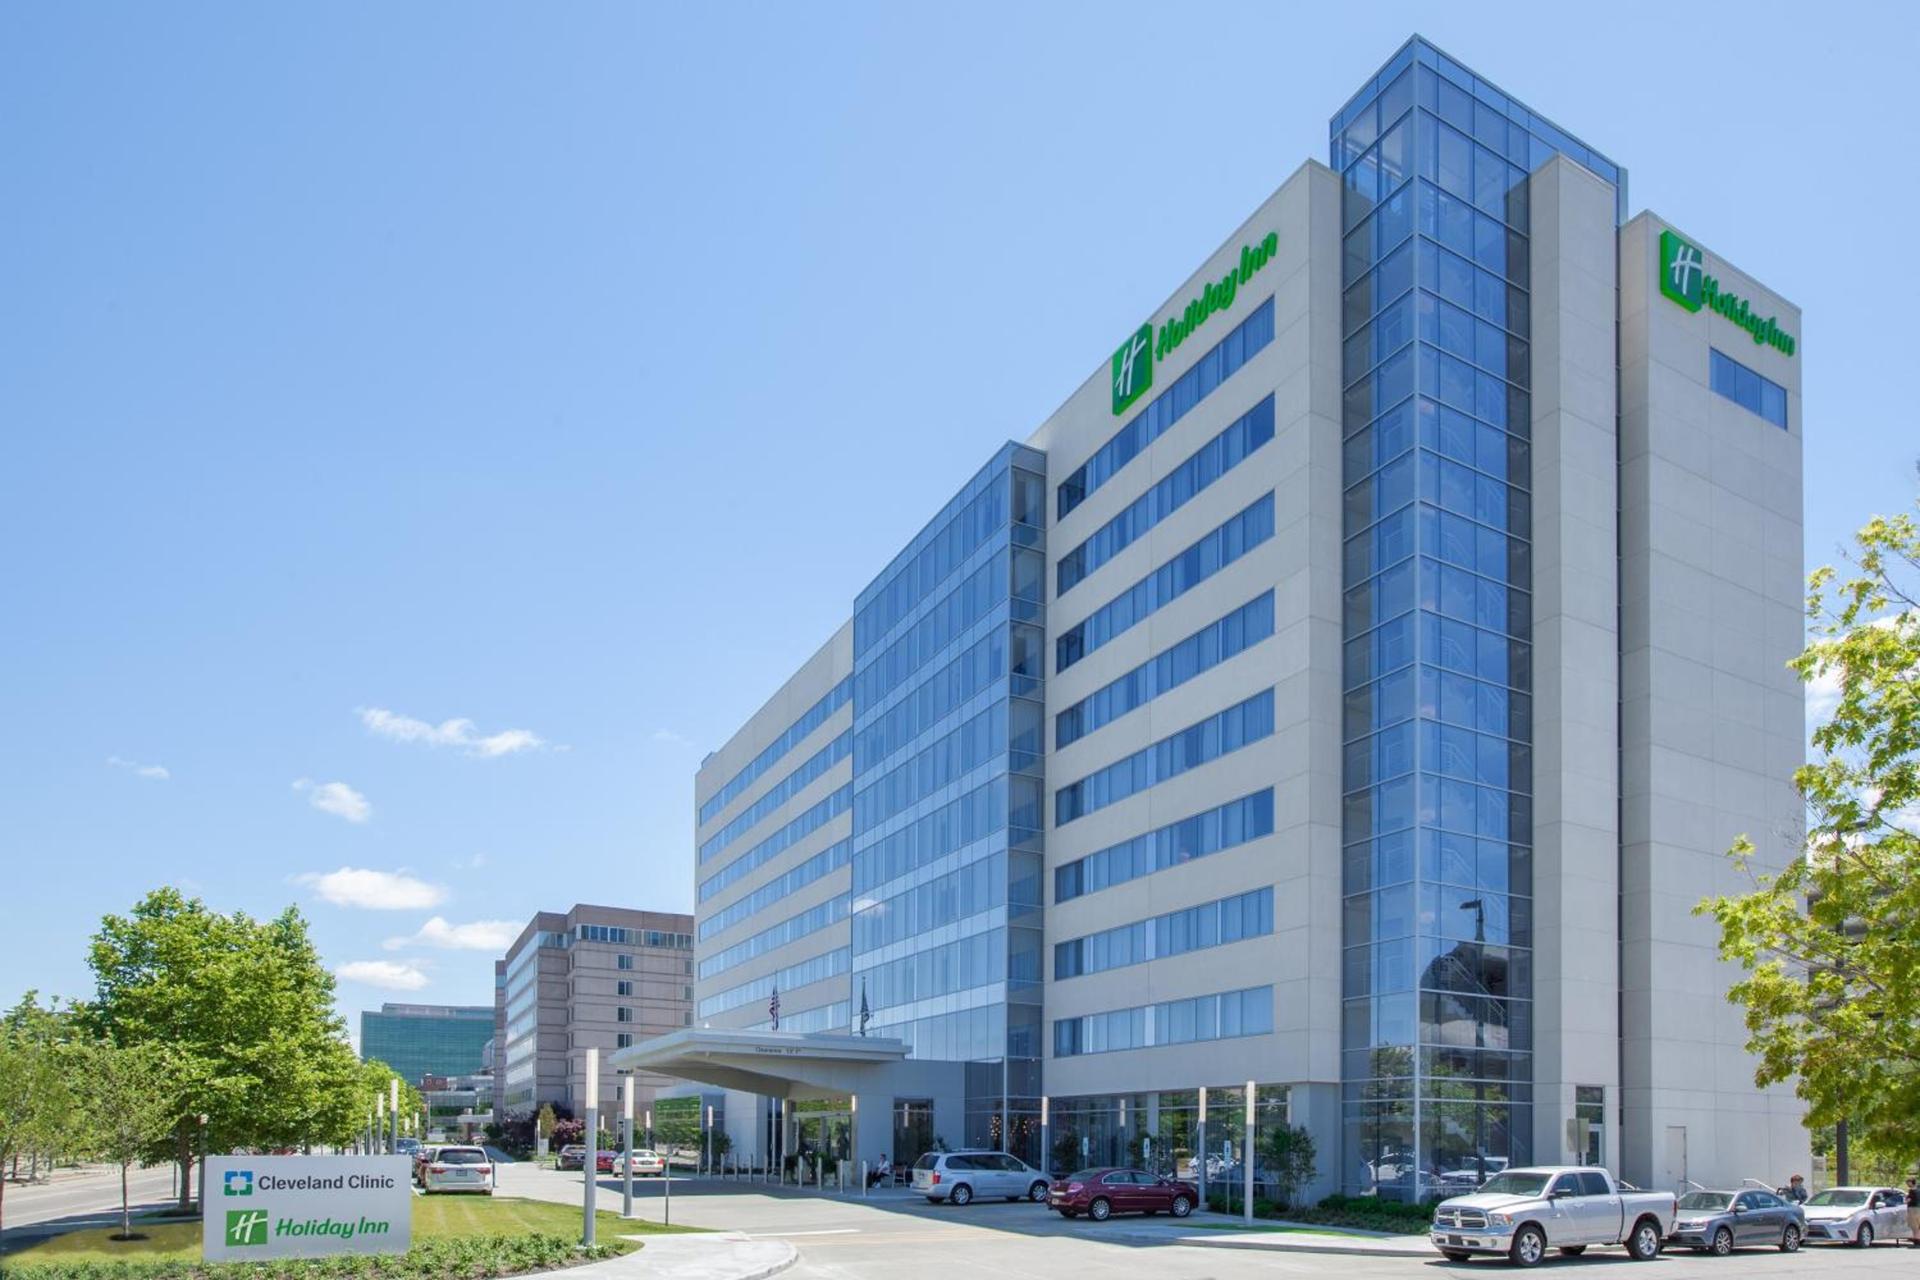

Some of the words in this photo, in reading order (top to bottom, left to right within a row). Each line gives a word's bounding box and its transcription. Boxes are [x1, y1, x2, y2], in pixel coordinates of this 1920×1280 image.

[1155, 268, 1238, 362] Holiday
[1238, 232, 1279, 285] Inn
[1701, 275, 1768, 345] Holiday
[1767, 316, 1796, 357] Inn
[258, 1175, 344, 1190] Cleveland
[348, 1174, 395, 1189] Clinic
[275, 1218, 355, 1239] Holiday
[358, 1216, 390, 1235] Inn
